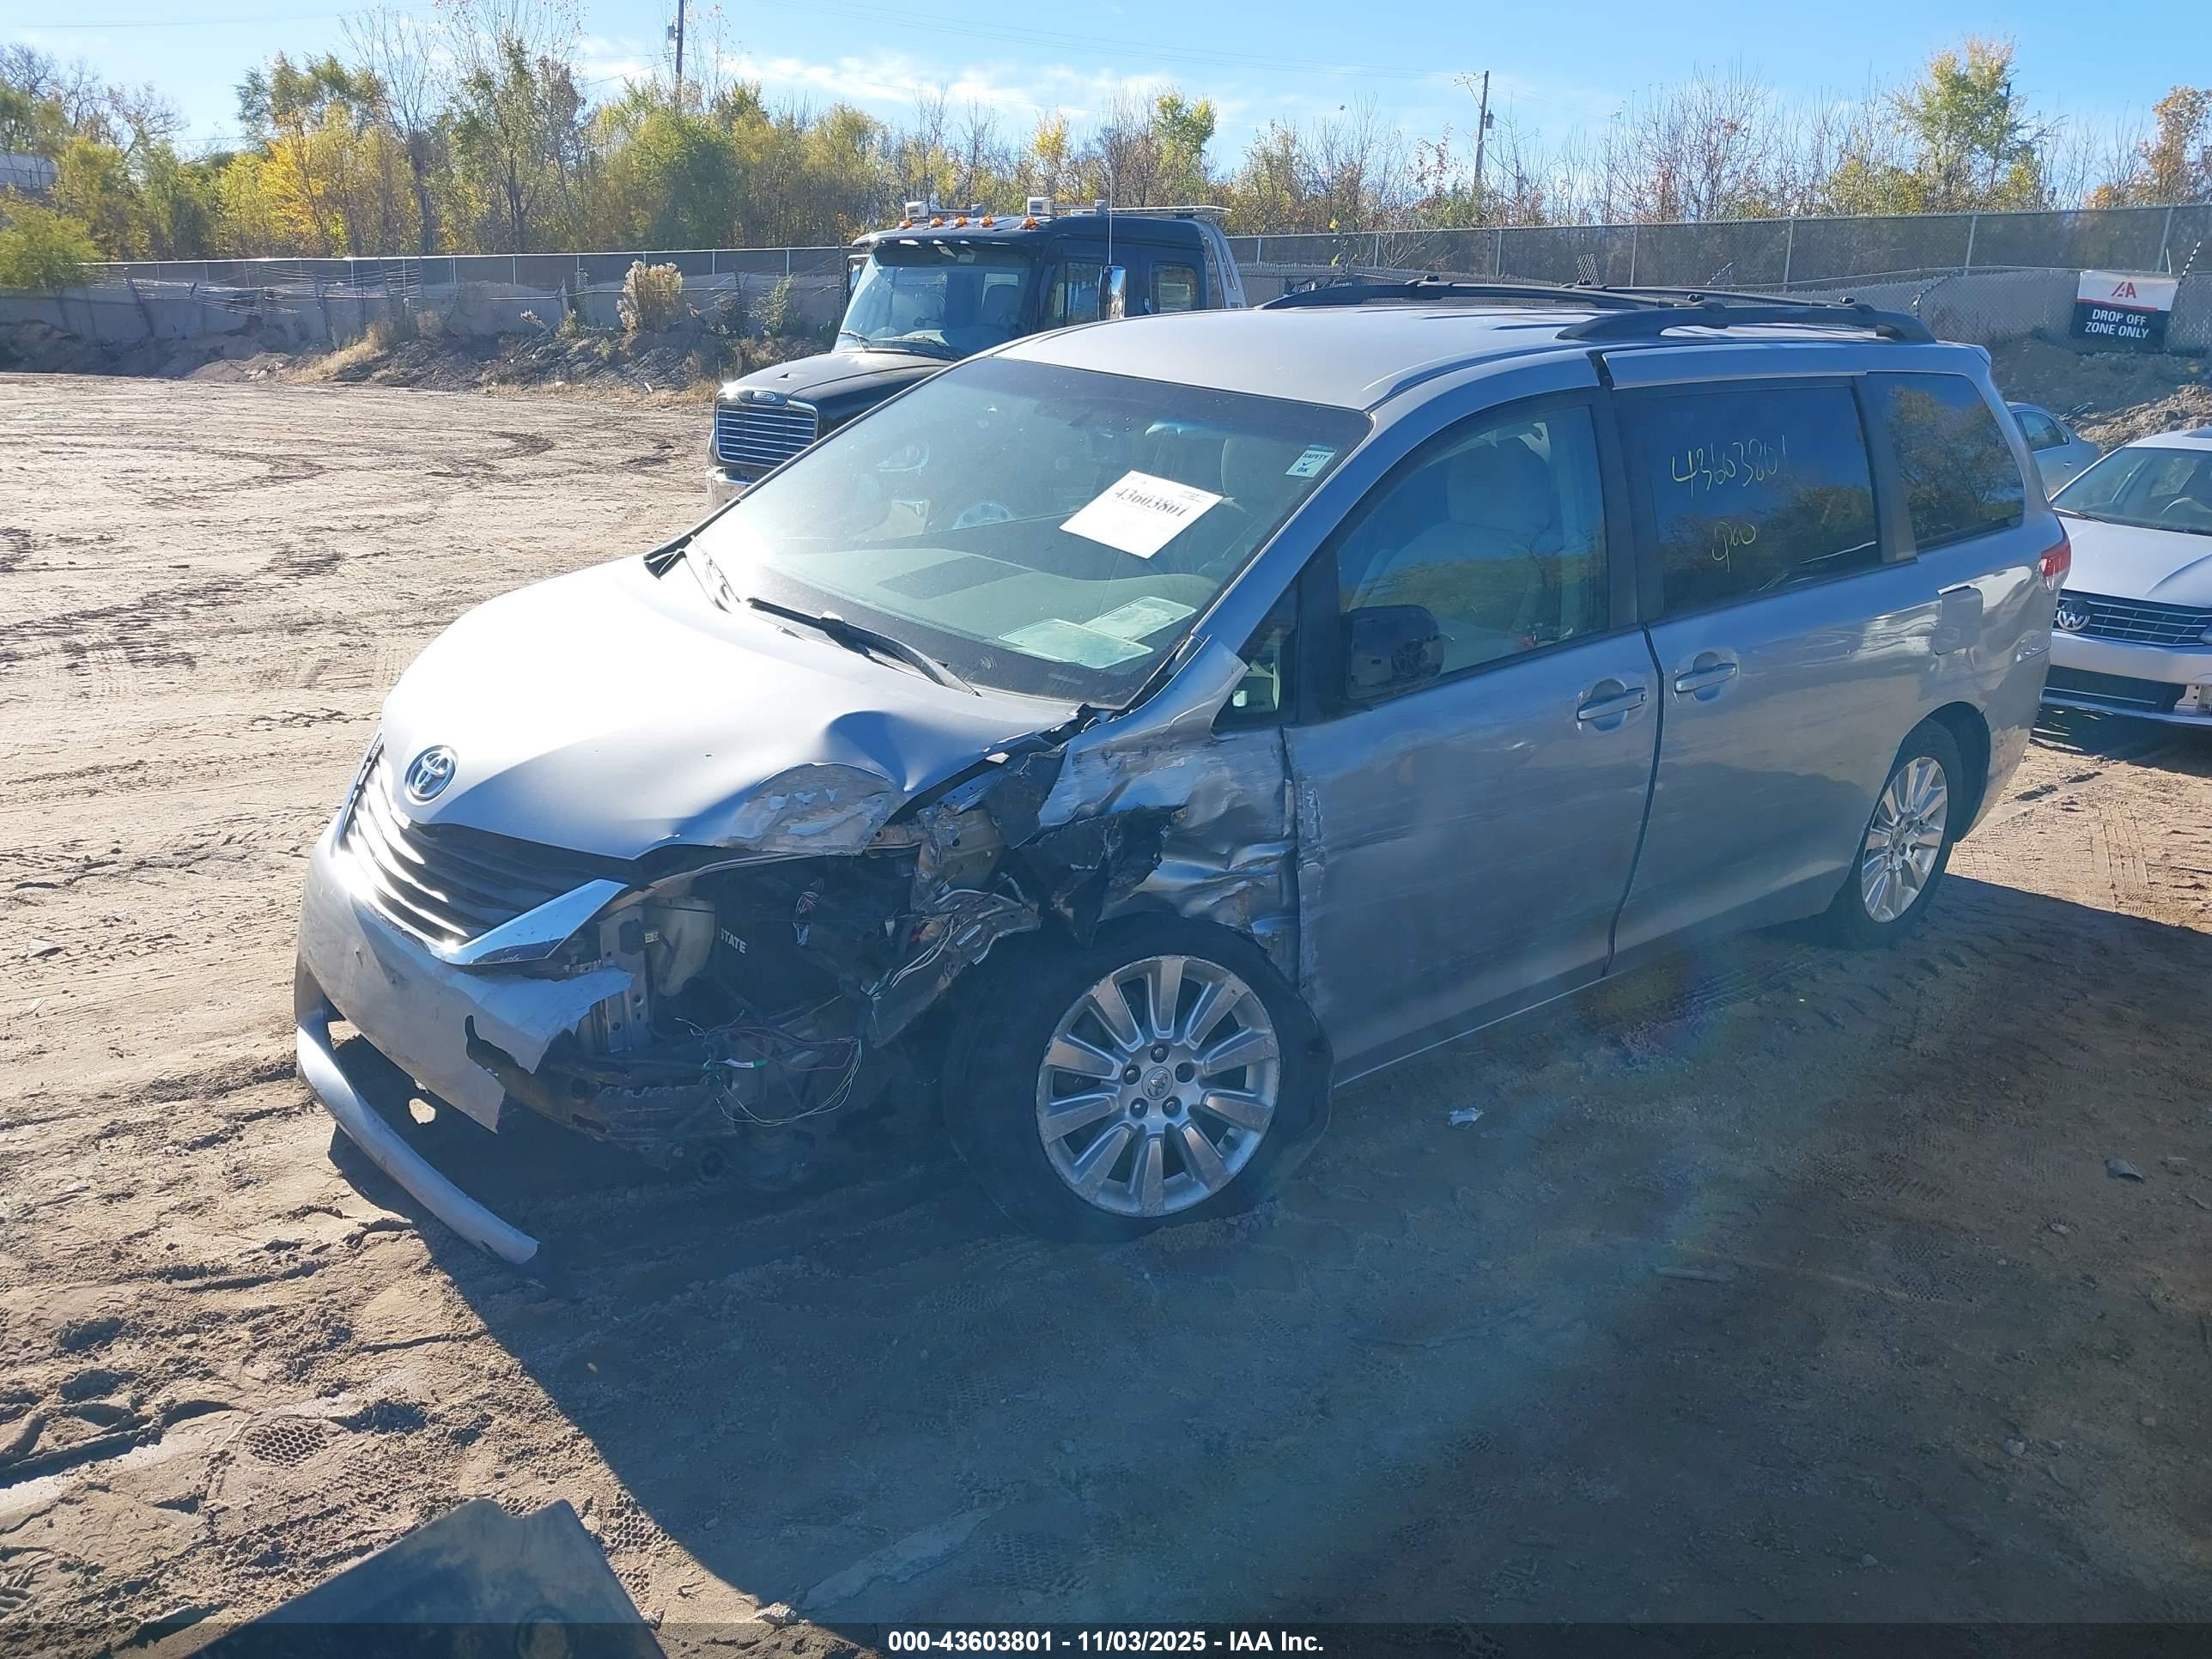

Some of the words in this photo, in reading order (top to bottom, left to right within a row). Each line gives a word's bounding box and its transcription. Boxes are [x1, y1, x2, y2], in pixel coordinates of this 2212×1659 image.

[2092, 308, 2124, 323] DROP
[2126, 313, 2147, 326] OFF
[2085, 321, 2116, 335] ZONE
[2118, 325, 2150, 339] ONLY
[1115, 486, 1191, 517] 43603801
